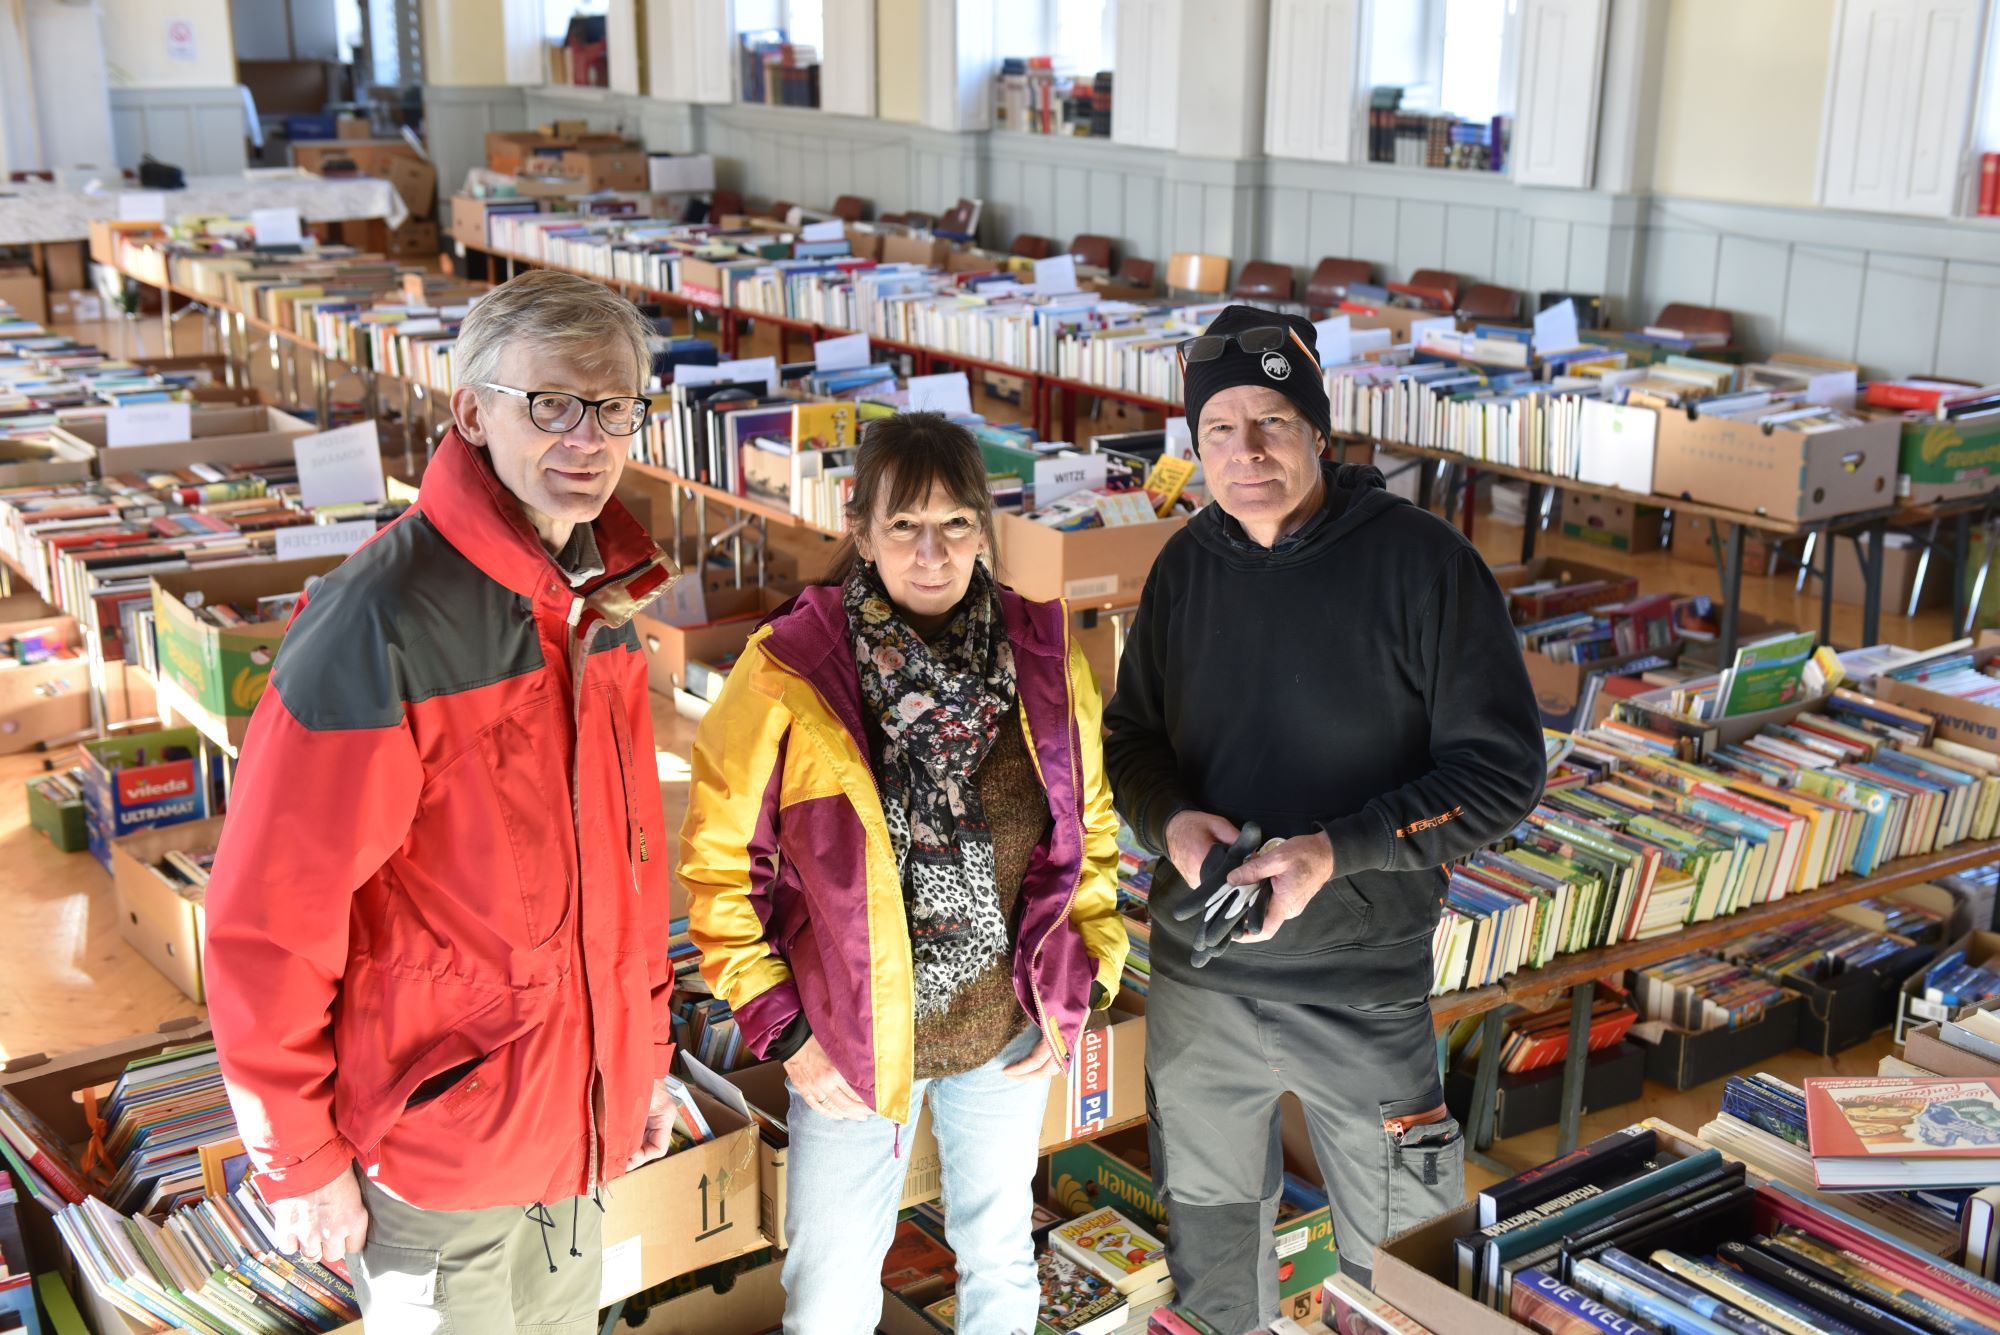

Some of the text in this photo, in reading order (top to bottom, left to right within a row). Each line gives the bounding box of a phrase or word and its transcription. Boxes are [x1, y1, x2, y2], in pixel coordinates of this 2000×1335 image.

[1054, 470, 1086, 484] WITZE
[127, 776, 189, 800] vileda
[120, 800, 195, 825] ULTRAMAT
[1085, 1028, 1103, 1091] diator
[1538, 1276, 1645, 1335] DIE WELT
